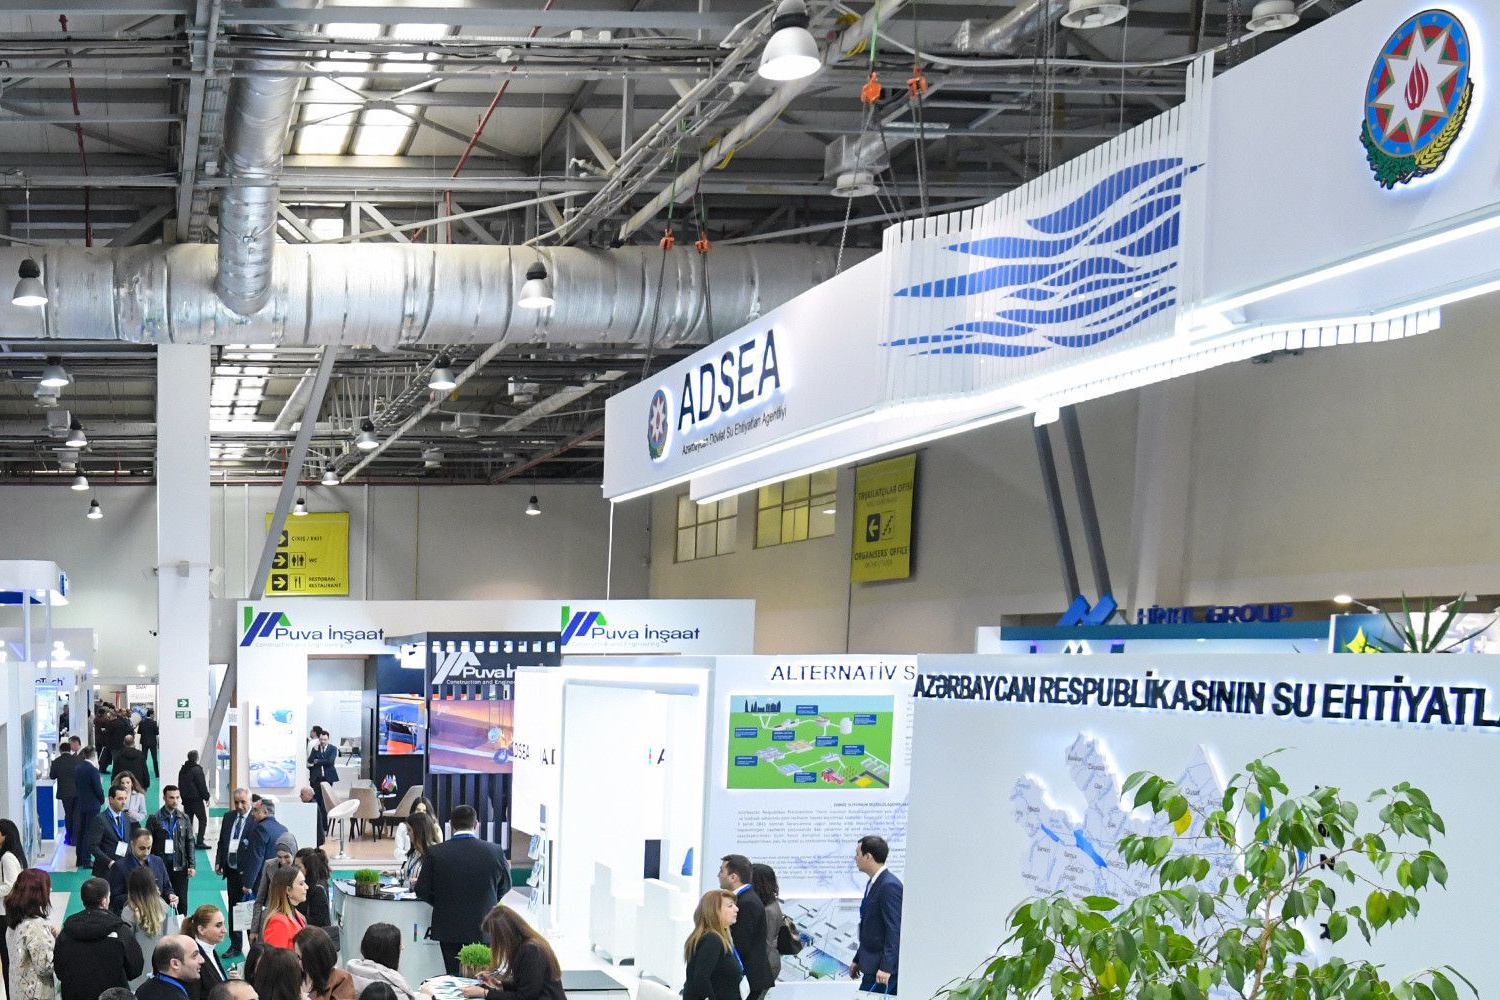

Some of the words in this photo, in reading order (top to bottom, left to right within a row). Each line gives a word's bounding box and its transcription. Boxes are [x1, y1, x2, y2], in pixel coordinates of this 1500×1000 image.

[678, 329, 781, 431] ADSEA
[726, 427, 734, 438] Su
[890, 546, 908, 556] OFFICE
[1206, 603, 1294, 624] GROUP
[275, 627, 323, 641] Puva
[328, 625, 384, 644] İnşaat
[592, 627, 639, 640] Puva
[644, 624, 700, 643] İnşaat
[463, 667, 505, 679] Puva
[771, 662, 897, 681] ALTERNATİV
[913, 673, 1036, 703] AZƏRBAYCAN
[1040, 670, 1265, 715] RESPUBLİKASININ
[1272, 683, 1316, 718] SU
[1321, 675, 1500, 728] EHTİYATL
